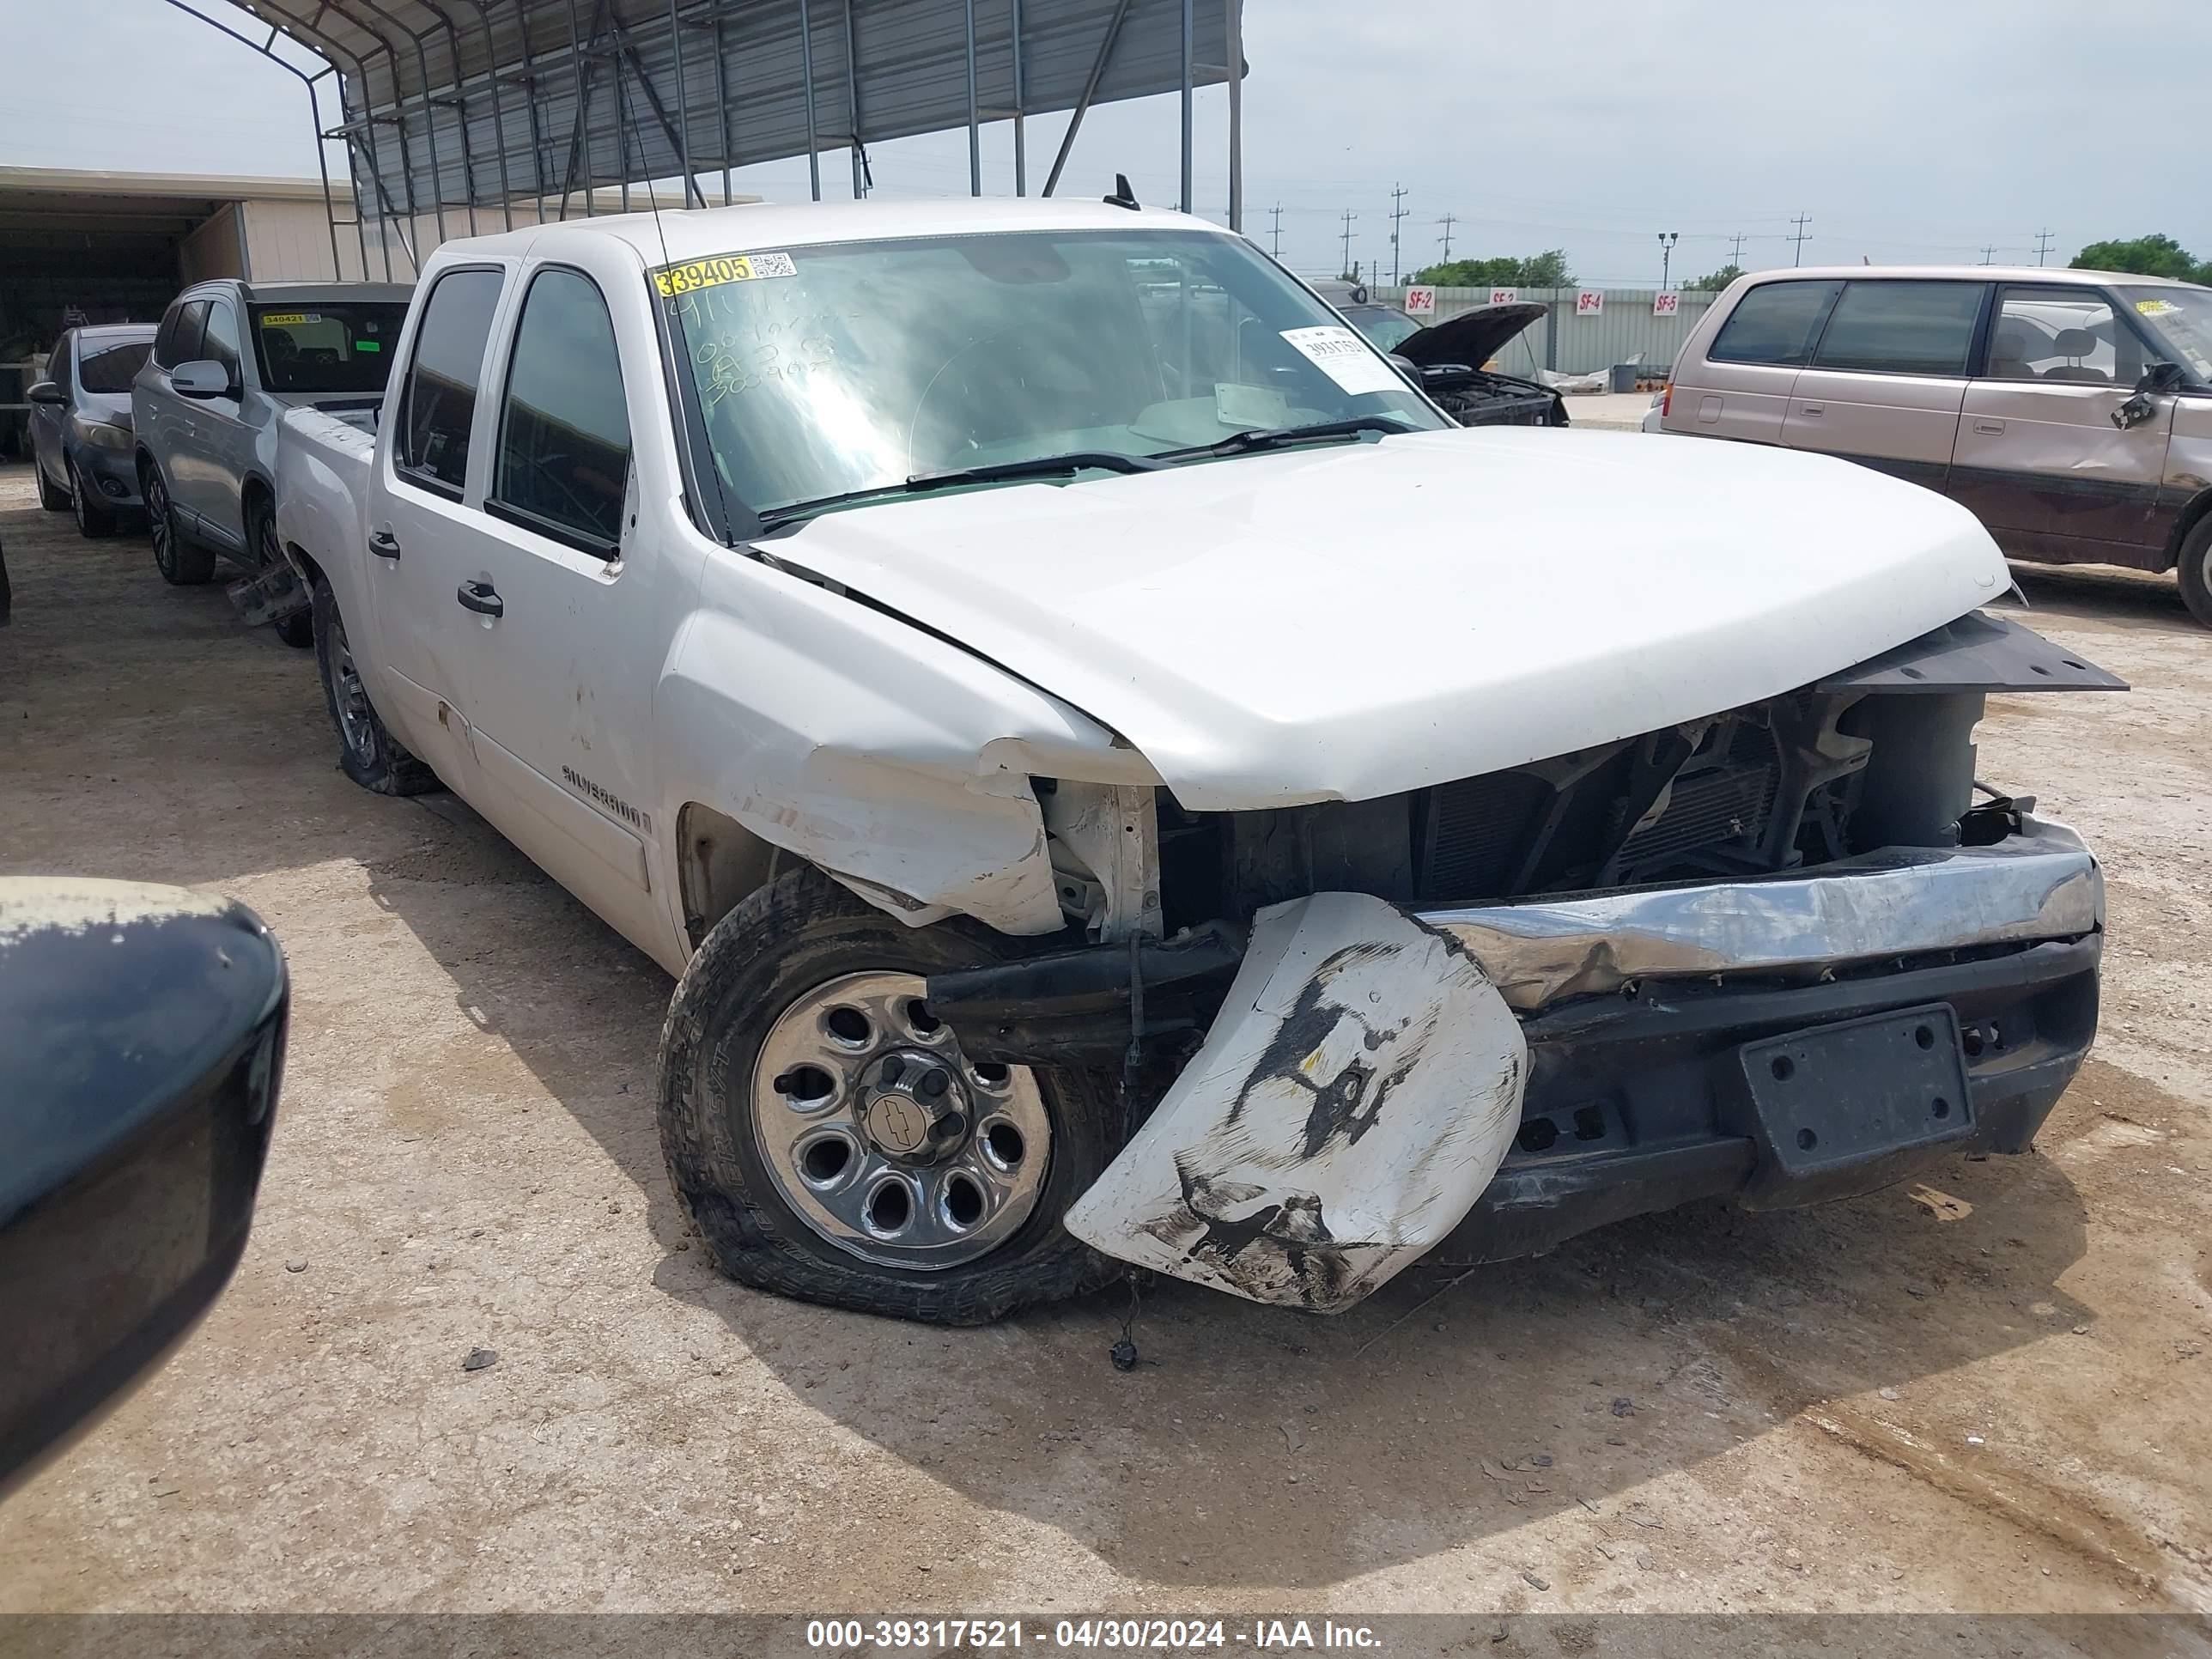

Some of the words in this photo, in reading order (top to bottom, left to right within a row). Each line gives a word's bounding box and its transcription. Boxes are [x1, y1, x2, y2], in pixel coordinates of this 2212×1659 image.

[656, 258, 750, 296] 339405
[1408, 290, 1432, 310] SF-2
[1578, 293, 1602, 311] SF-4
[1656, 294, 1677, 312] SF-5
[562, 764, 641, 828] SILVERADO
